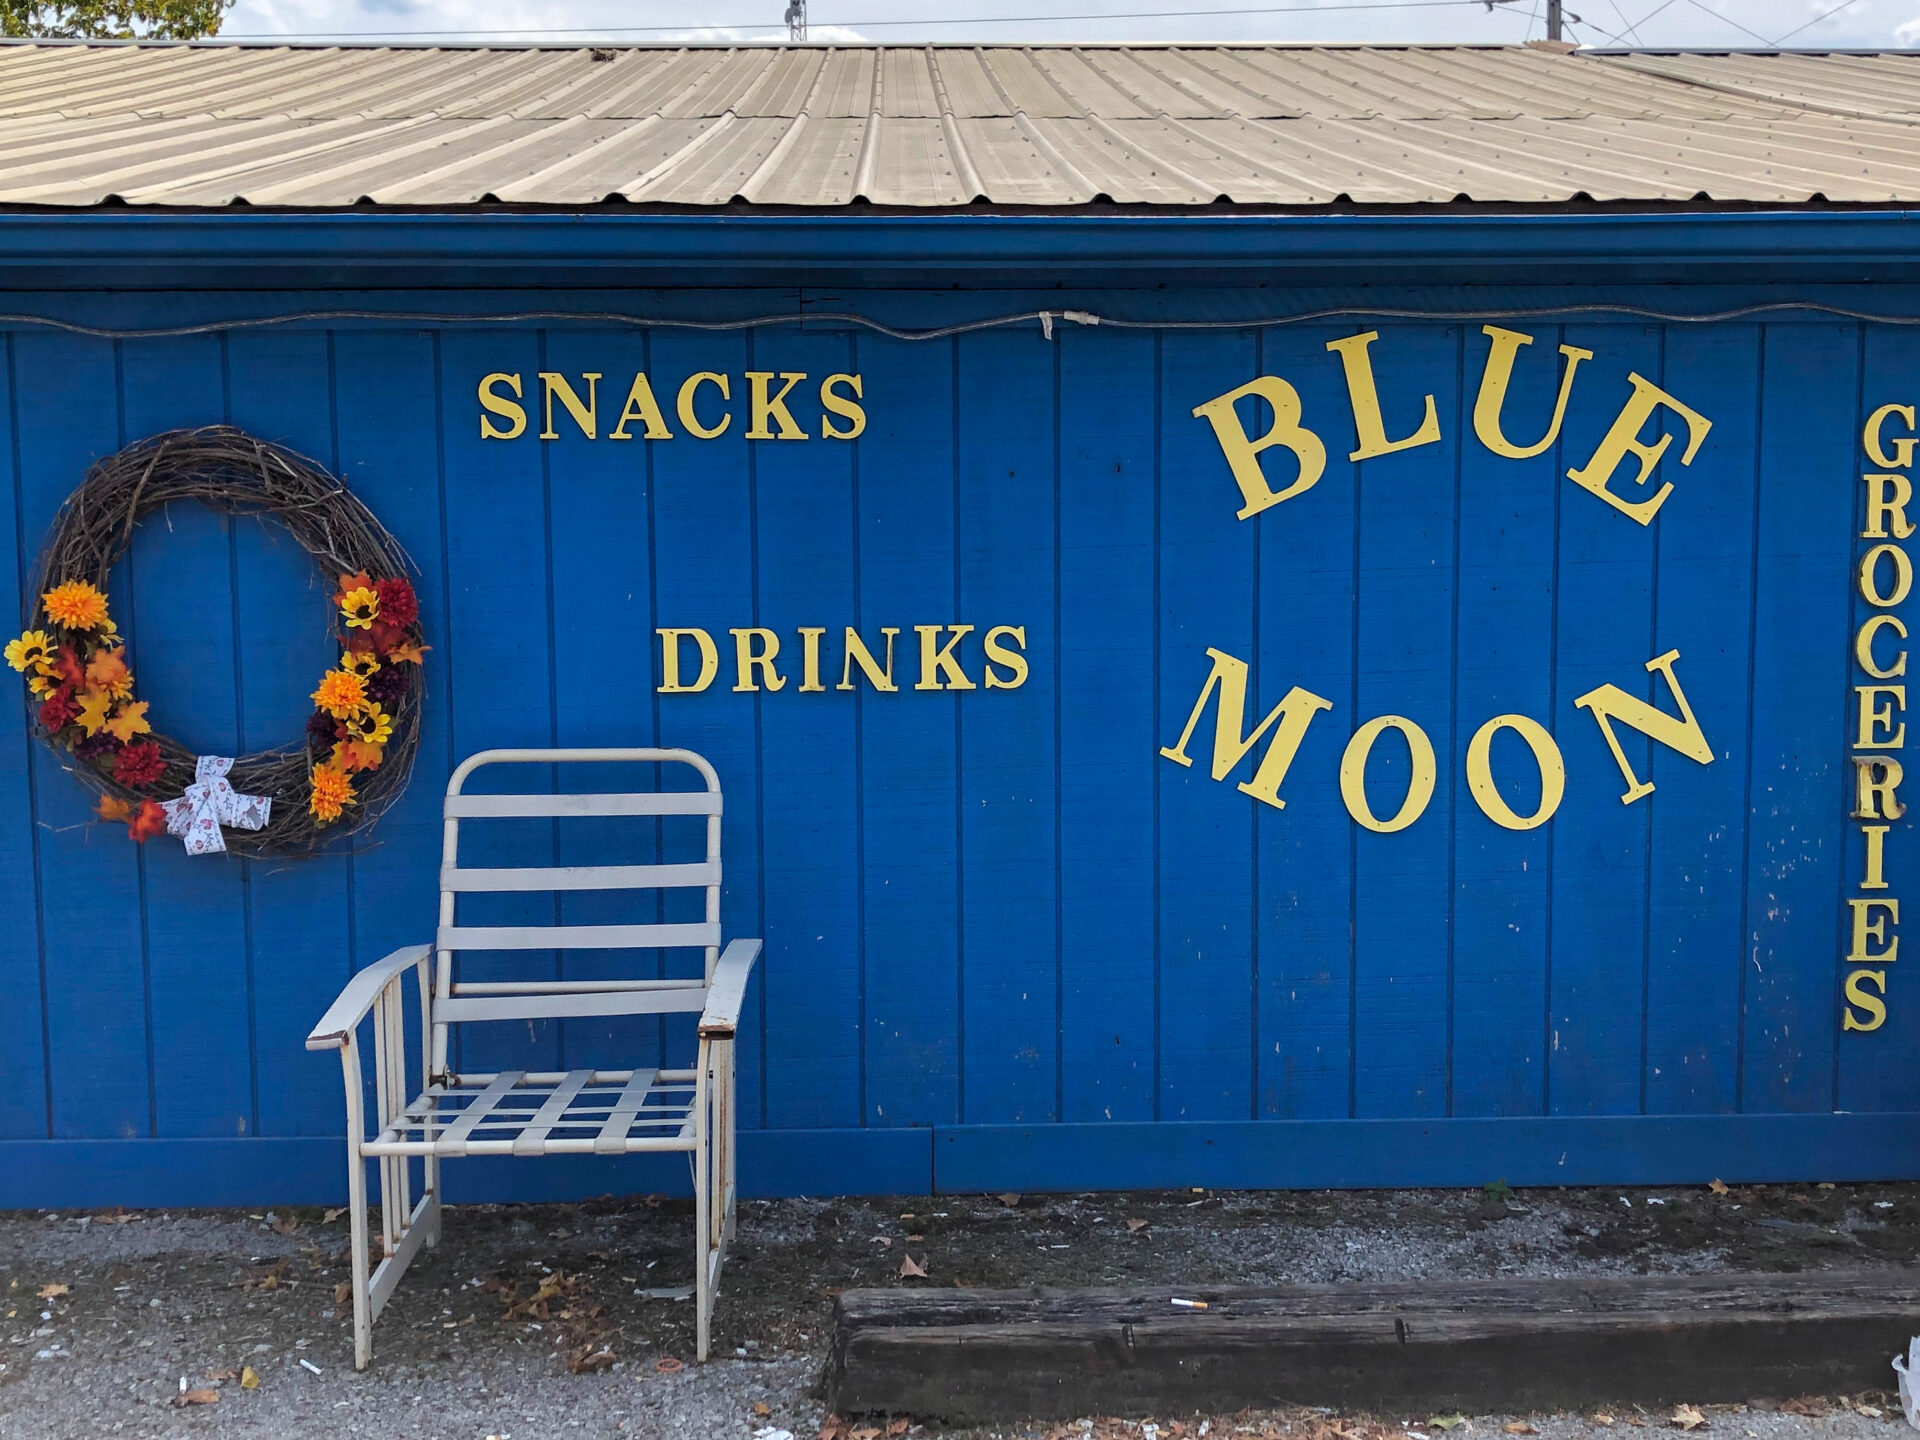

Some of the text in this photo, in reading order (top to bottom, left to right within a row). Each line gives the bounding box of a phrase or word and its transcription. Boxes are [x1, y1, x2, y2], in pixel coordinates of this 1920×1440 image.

[477, 371, 867, 441] SNACKS
[1192, 324, 1712, 527] BLUE
[656, 624, 1030, 694] DRINKS
[1159, 647, 1714, 833] MOON
[1843, 403, 1919, 1032] GROCERIES
